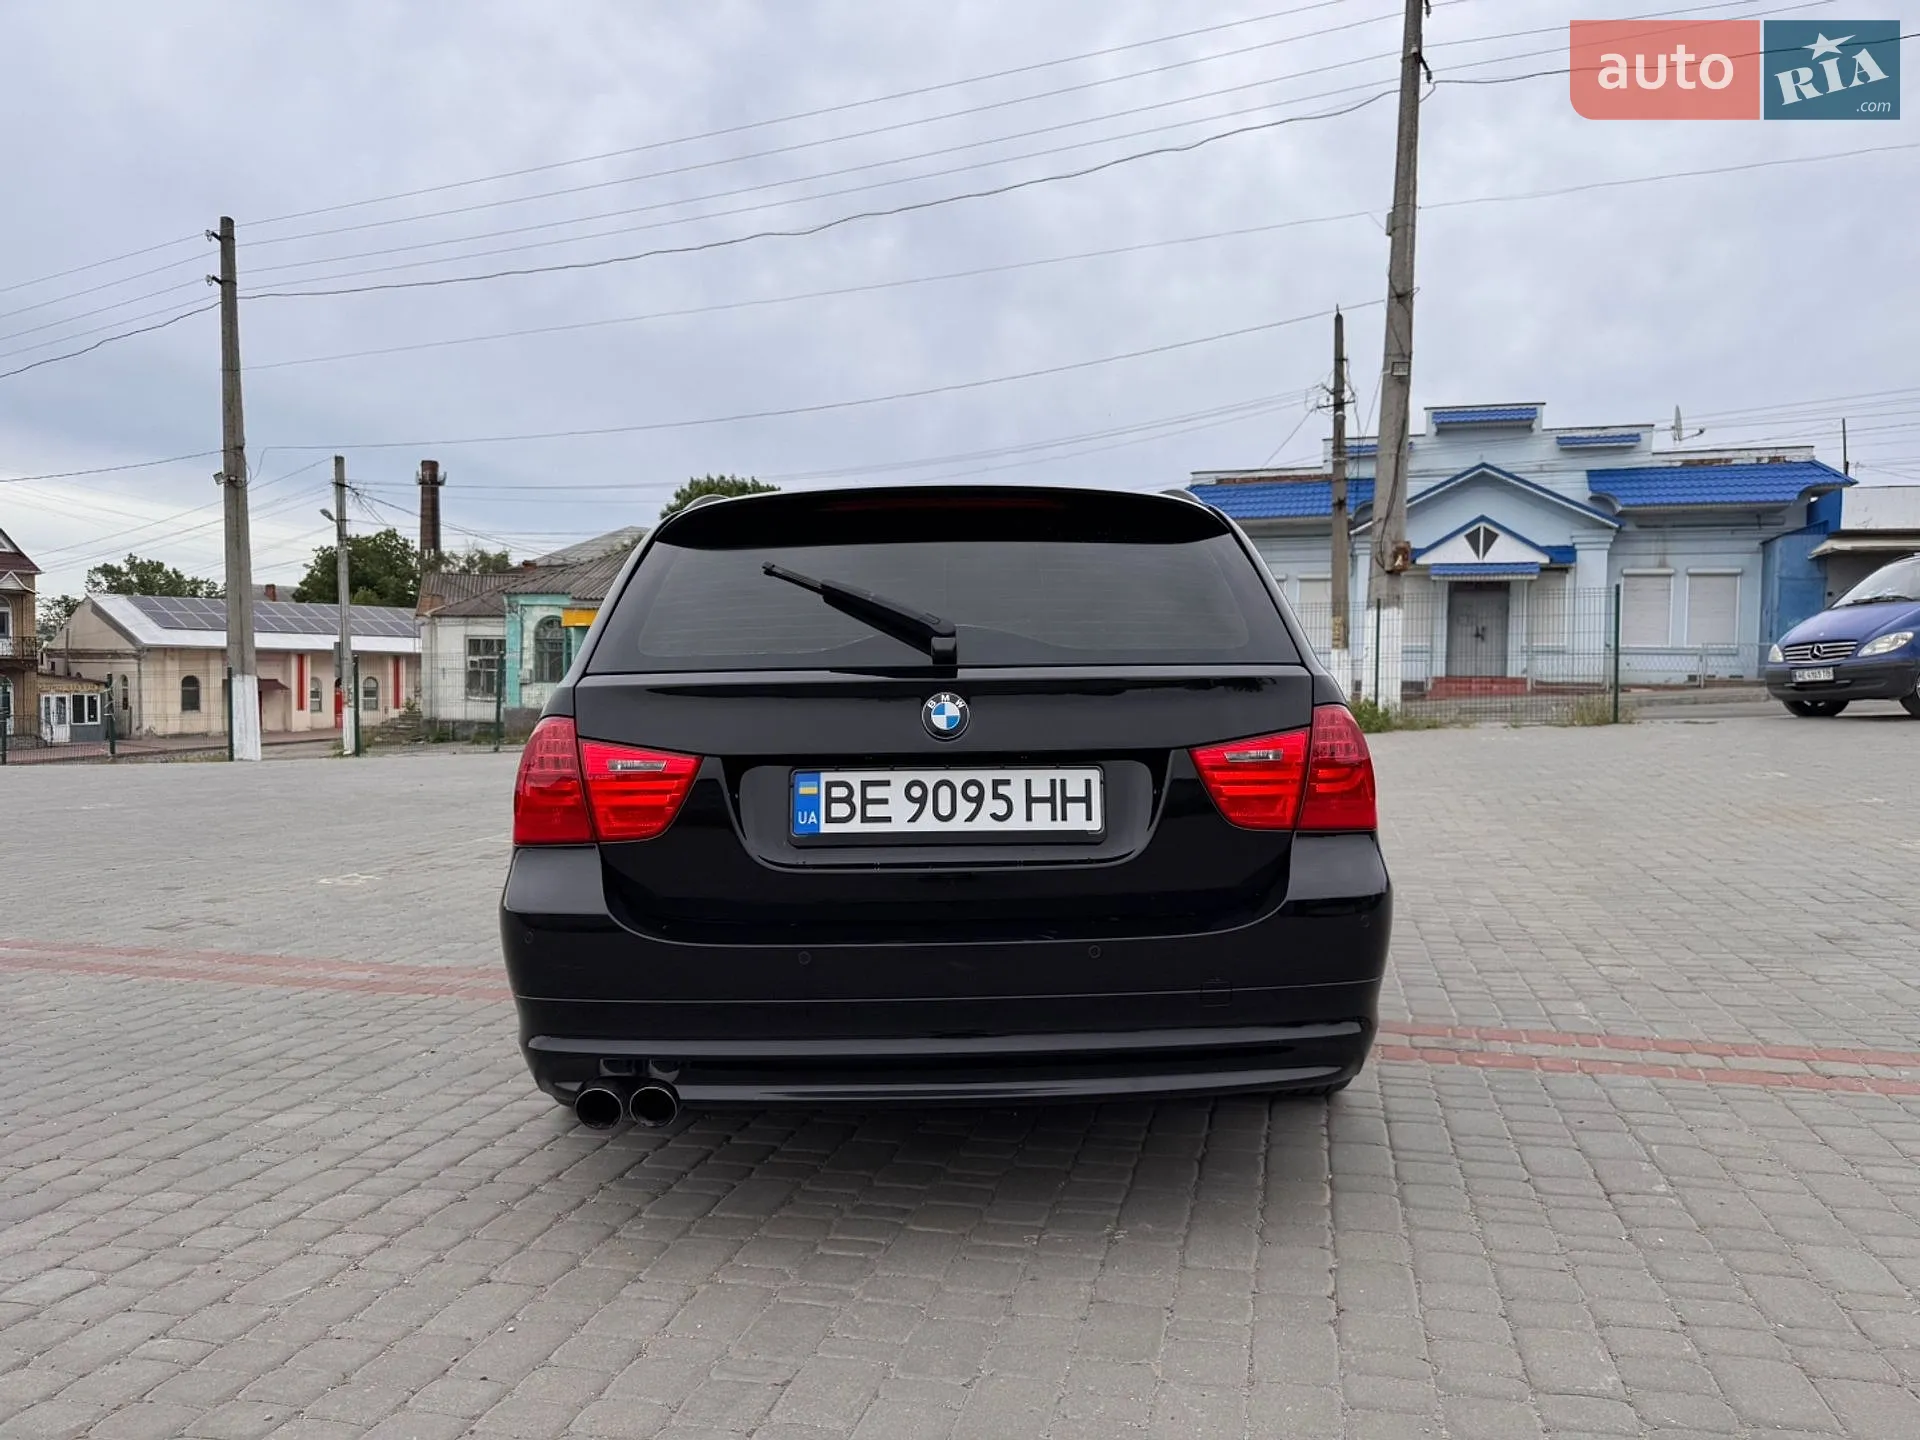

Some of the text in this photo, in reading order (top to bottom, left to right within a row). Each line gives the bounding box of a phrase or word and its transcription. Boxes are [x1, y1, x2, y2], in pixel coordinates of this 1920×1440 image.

[927, 694, 966, 709] BMW
[824, 778, 1093, 824] BE 9095 HH
[798, 811, 817, 825] UA
